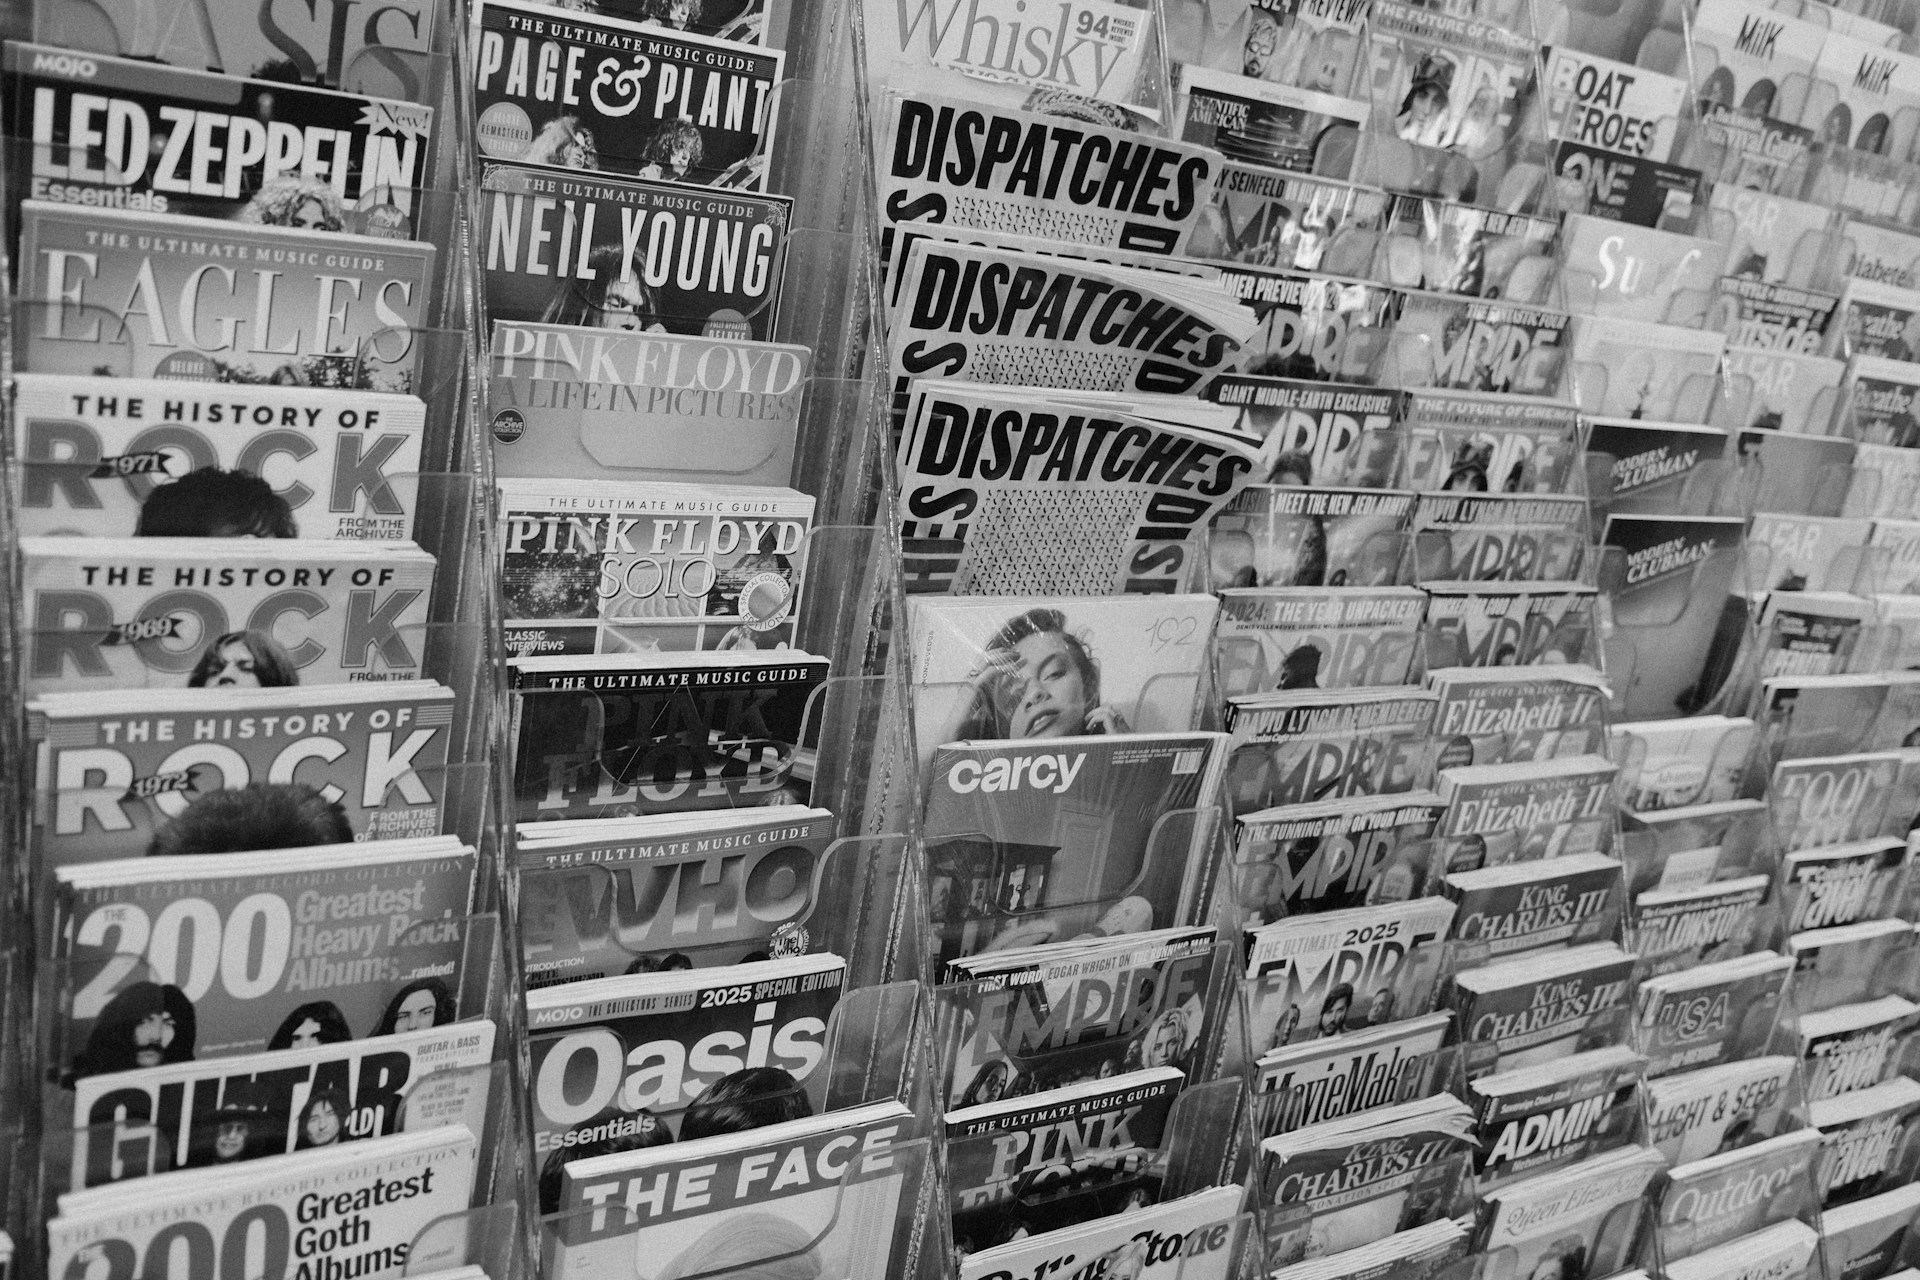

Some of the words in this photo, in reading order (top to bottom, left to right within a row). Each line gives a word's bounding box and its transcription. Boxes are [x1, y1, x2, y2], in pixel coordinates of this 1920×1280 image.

[1076, 10, 1110, 39] 94
[1375, 1, 1406, 19] THE
[1406, 10, 1467, 34] FUTURE
[1466, 24, 1486, 38] OF
[508, 15, 543, 35] THE
[551, 23, 643, 53] ULTIMATE
[648, 41, 702, 64] MUSIC
[706, 51, 756, 73] GUIDE
[897, 0, 1129, 97] Whisky
[34, 54, 97, 79] MOJO
[477, 30, 586, 107] PAGE
[590, 55, 651, 118] &
[653, 62, 771, 136] PLANT
[376, 103, 429, 132] New!
[1189, 109, 1248, 131] AMERICAN
[1192, 94, 1251, 119] SCIENTIFIC
[33, 87, 151, 186] LED
[152, 105, 418, 218] ZEPPELIN
[890, 98, 1209, 222] DISPATCHES
[32, 178, 168, 213] Essentials
[523, 177, 557, 193] THE
[562, 181, 647, 203] ULTIMATE
[652, 193, 702, 212] MUSIC
[706, 201, 755, 219] GUIDE
[1229, 170, 1286, 198] SEINFELD
[1562, 151, 1637, 206] ONE
[86, 230, 129, 247] THE
[138, 236, 248, 261] ULTIMATE
[255, 248, 319, 267] MUSIC
[325, 253, 386, 273] GUIDE
[486, 191, 597, 281] NEIL
[619, 206, 774, 298] YOUNG
[38, 248, 413, 364] EAGLES
[909, 253, 1242, 369] DISPATCHES
[497, 327, 627, 386] PINK
[629, 338, 802, 396] FLOYD
[72, 395, 144, 419] THE
[163, 401, 323, 428] HISTORY
[338, 409, 381, 429] OF
[499, 382, 519, 406] A
[523, 379, 601, 411] LIFE
[607, 382, 650, 413] IN
[649, 386, 797, 423] PICTURES
[1219, 383, 1255, 404] GIANT
[1255, 386, 1335, 410] MIDDLE-EARTH
[1334, 392, 1393, 414] EXCLUSIVE!
[1416, 398, 1445, 412] THE
[1447, 400, 1504, 417] FUTURE
[1504, 406, 1522, 417] OF
[21, 417, 410, 515] ROCK
[107, 453, 160, 475] 1971
[916, 399, 1252, 497] DISPATCHES
[548, 497, 581, 509] THE
[587, 499, 666, 512] ULTIMATE
[674, 501, 724, 513] MUSIC
[731, 502, 778, 514] GUIDE
[1274, 492, 1307, 514] MEET
[1306, 493, 1328, 515] THE
[1327, 493, 1353, 515] NEW
[1351, 494, 1377, 515] JEDI
[1376, 496, 1411, 517] ARMY!
[505, 515, 640, 556] PINK
[649, 517, 806, 556] FLOYD
[1626, 535, 1686, 567] MODERN
[82, 567, 155, 586] THE
[174, 567, 335, 587] HISTORY
[351, 569, 395, 587] OF
[596, 556, 718, 600] SOLO
[1626, 537, 1717, 584] CLUBMAN
[30, 588, 424, 679] ROCK
[1225, 602, 1268, 623] 2024:
[1273, 601, 1305, 622] THE
[1345, 600, 1423, 621] UNPACKED!
[549, 676, 587, 691] THE
[592, 673, 690, 689] ULTIMATE
[695, 670, 751, 685] MUSIC
[756, 668, 809, 682] GUIDE
[102, 719, 176, 744] THE
[193, 710, 355, 741] HISTORY
[369, 707, 413, 729] OF
[1239, 710, 1287, 735] DAVID
[1287, 707, 1341, 734] LYNCH
[1442, 693, 1565, 736] Elizabeth
[1568, 693, 1598, 725] II
[55, 727, 439, 836] ROCK
[134, 771, 188, 797] 1972
[948, 752, 1088, 794] carcy
[1247, 824, 1268, 842] THE
[1269, 821, 1323, 841] RUNNING
[1351, 815, 1367, 833] ON
[1367, 811, 1395, 830] YOUR
[1453, 788, 1577, 837] Elizabeth
[1579, 783, 1610, 818] II
[546, 852, 584, 869] THE
[591, 841, 690, 863] ULTIMATE
[695, 835, 751, 852] MUSIC
[756, 826, 810, 843] GUIDE
[1237, 822, 1429, 905] EMPIRE
[297, 880, 426, 922] Greatest
[1459, 900, 1575, 941] CHARLES
[1571, 888, 1610, 923] III
[1516, 883, 1569, 912] KING
[73, 892, 292, 1020] 200
[291, 920, 381, 959] Heavy
[387, 911, 460, 948] Rock
[284, 955, 400, 994] Albums
[1251, 931, 1437, 1011] EMPIRE
[535, 1006, 584, 1025] MOJO
[588, 1005, 602, 1018] THE
[602, 997, 662, 1016] COLLECTORS'
[663, 992, 695, 1008] SERIES
[701, 985, 752, 1009] 2025
[753, 976, 799, 1001] SPECIAL
[800, 967, 844, 994] EDITION
[965, 957, 1203, 1058] EMPIRE
[1471, 993, 1589, 1042] CHARLES
[1584, 980, 1628, 1014] III
[1530, 978, 1583, 1010] KING
[536, 1000, 827, 1125] Oasis
[967, 1121, 995, 1136] THE
[1001, 1104, 1076, 1129] ULTIMATE
[1080, 1094, 1124, 1112] MUSIC
[1127, 1084, 1166, 1103] GUIDE
[1258, 1046, 1440, 1137] MovieMaker
[1651, 1094, 1713, 1145] LIGHT
[1711, 1090, 1729, 1123] &
[1731, 1075, 1781, 1115] SEED
[535, 1113, 657, 1152] Essentials
[984, 1105, 1143, 1185] PINK
[1484, 1091, 1617, 1167] ADMIN
[1343, 1137, 1410, 1166] KING
[295, 1167, 434, 1225] Greatest
[582, 1162, 718, 1233] THE
[735, 1124, 900, 1201] FACE
[1274, 1151, 1414, 1205] CHARLES
[294, 1214, 370, 1260] Goth
[1506, 1200, 1562, 1236] Queen
